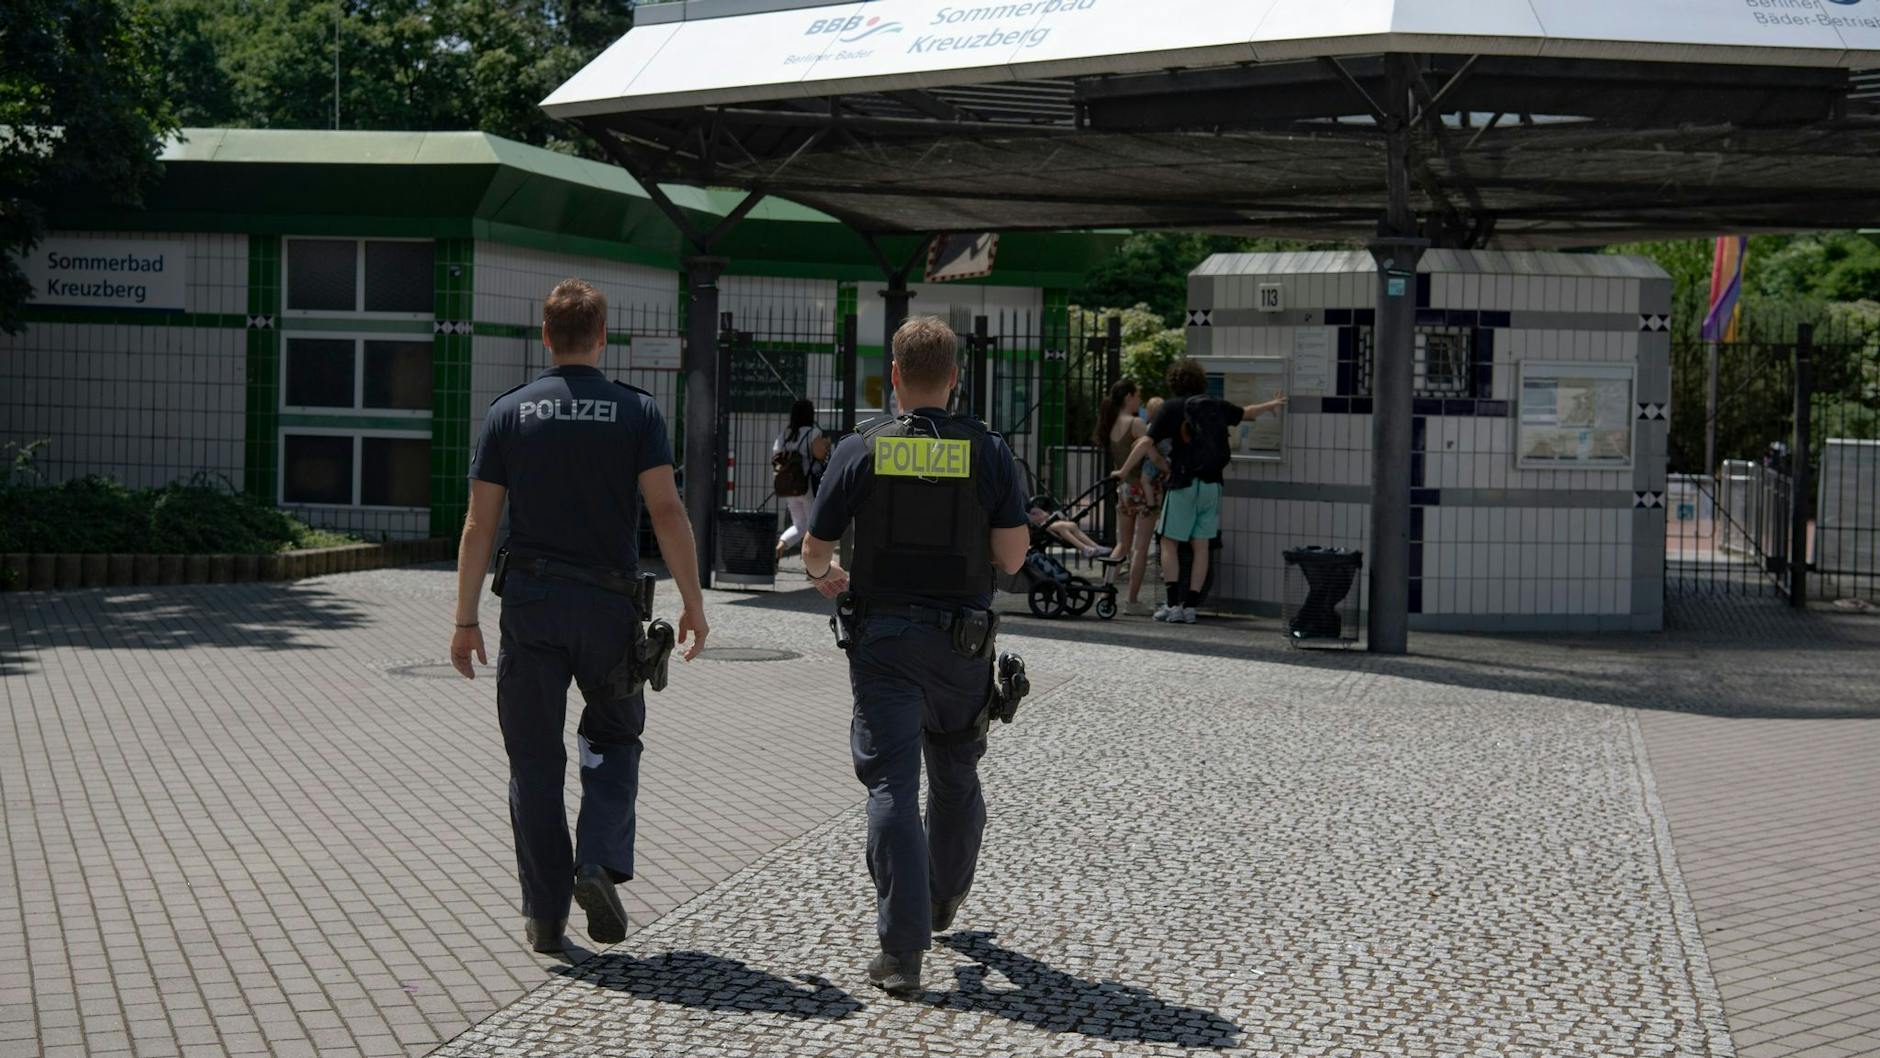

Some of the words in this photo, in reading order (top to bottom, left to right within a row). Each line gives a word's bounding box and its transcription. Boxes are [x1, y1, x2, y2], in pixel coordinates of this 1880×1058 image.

[804, 15, 864, 36] BBB
[906, 26, 1051, 55] Kreuzberg
[47, 252, 164, 273] Sommerbad
[47, 278, 147, 303] Kreuzberg
[1261, 288, 1278, 307] 113
[519, 399, 618, 423] POLIZEI
[879, 441, 967, 474] POLIZEI
